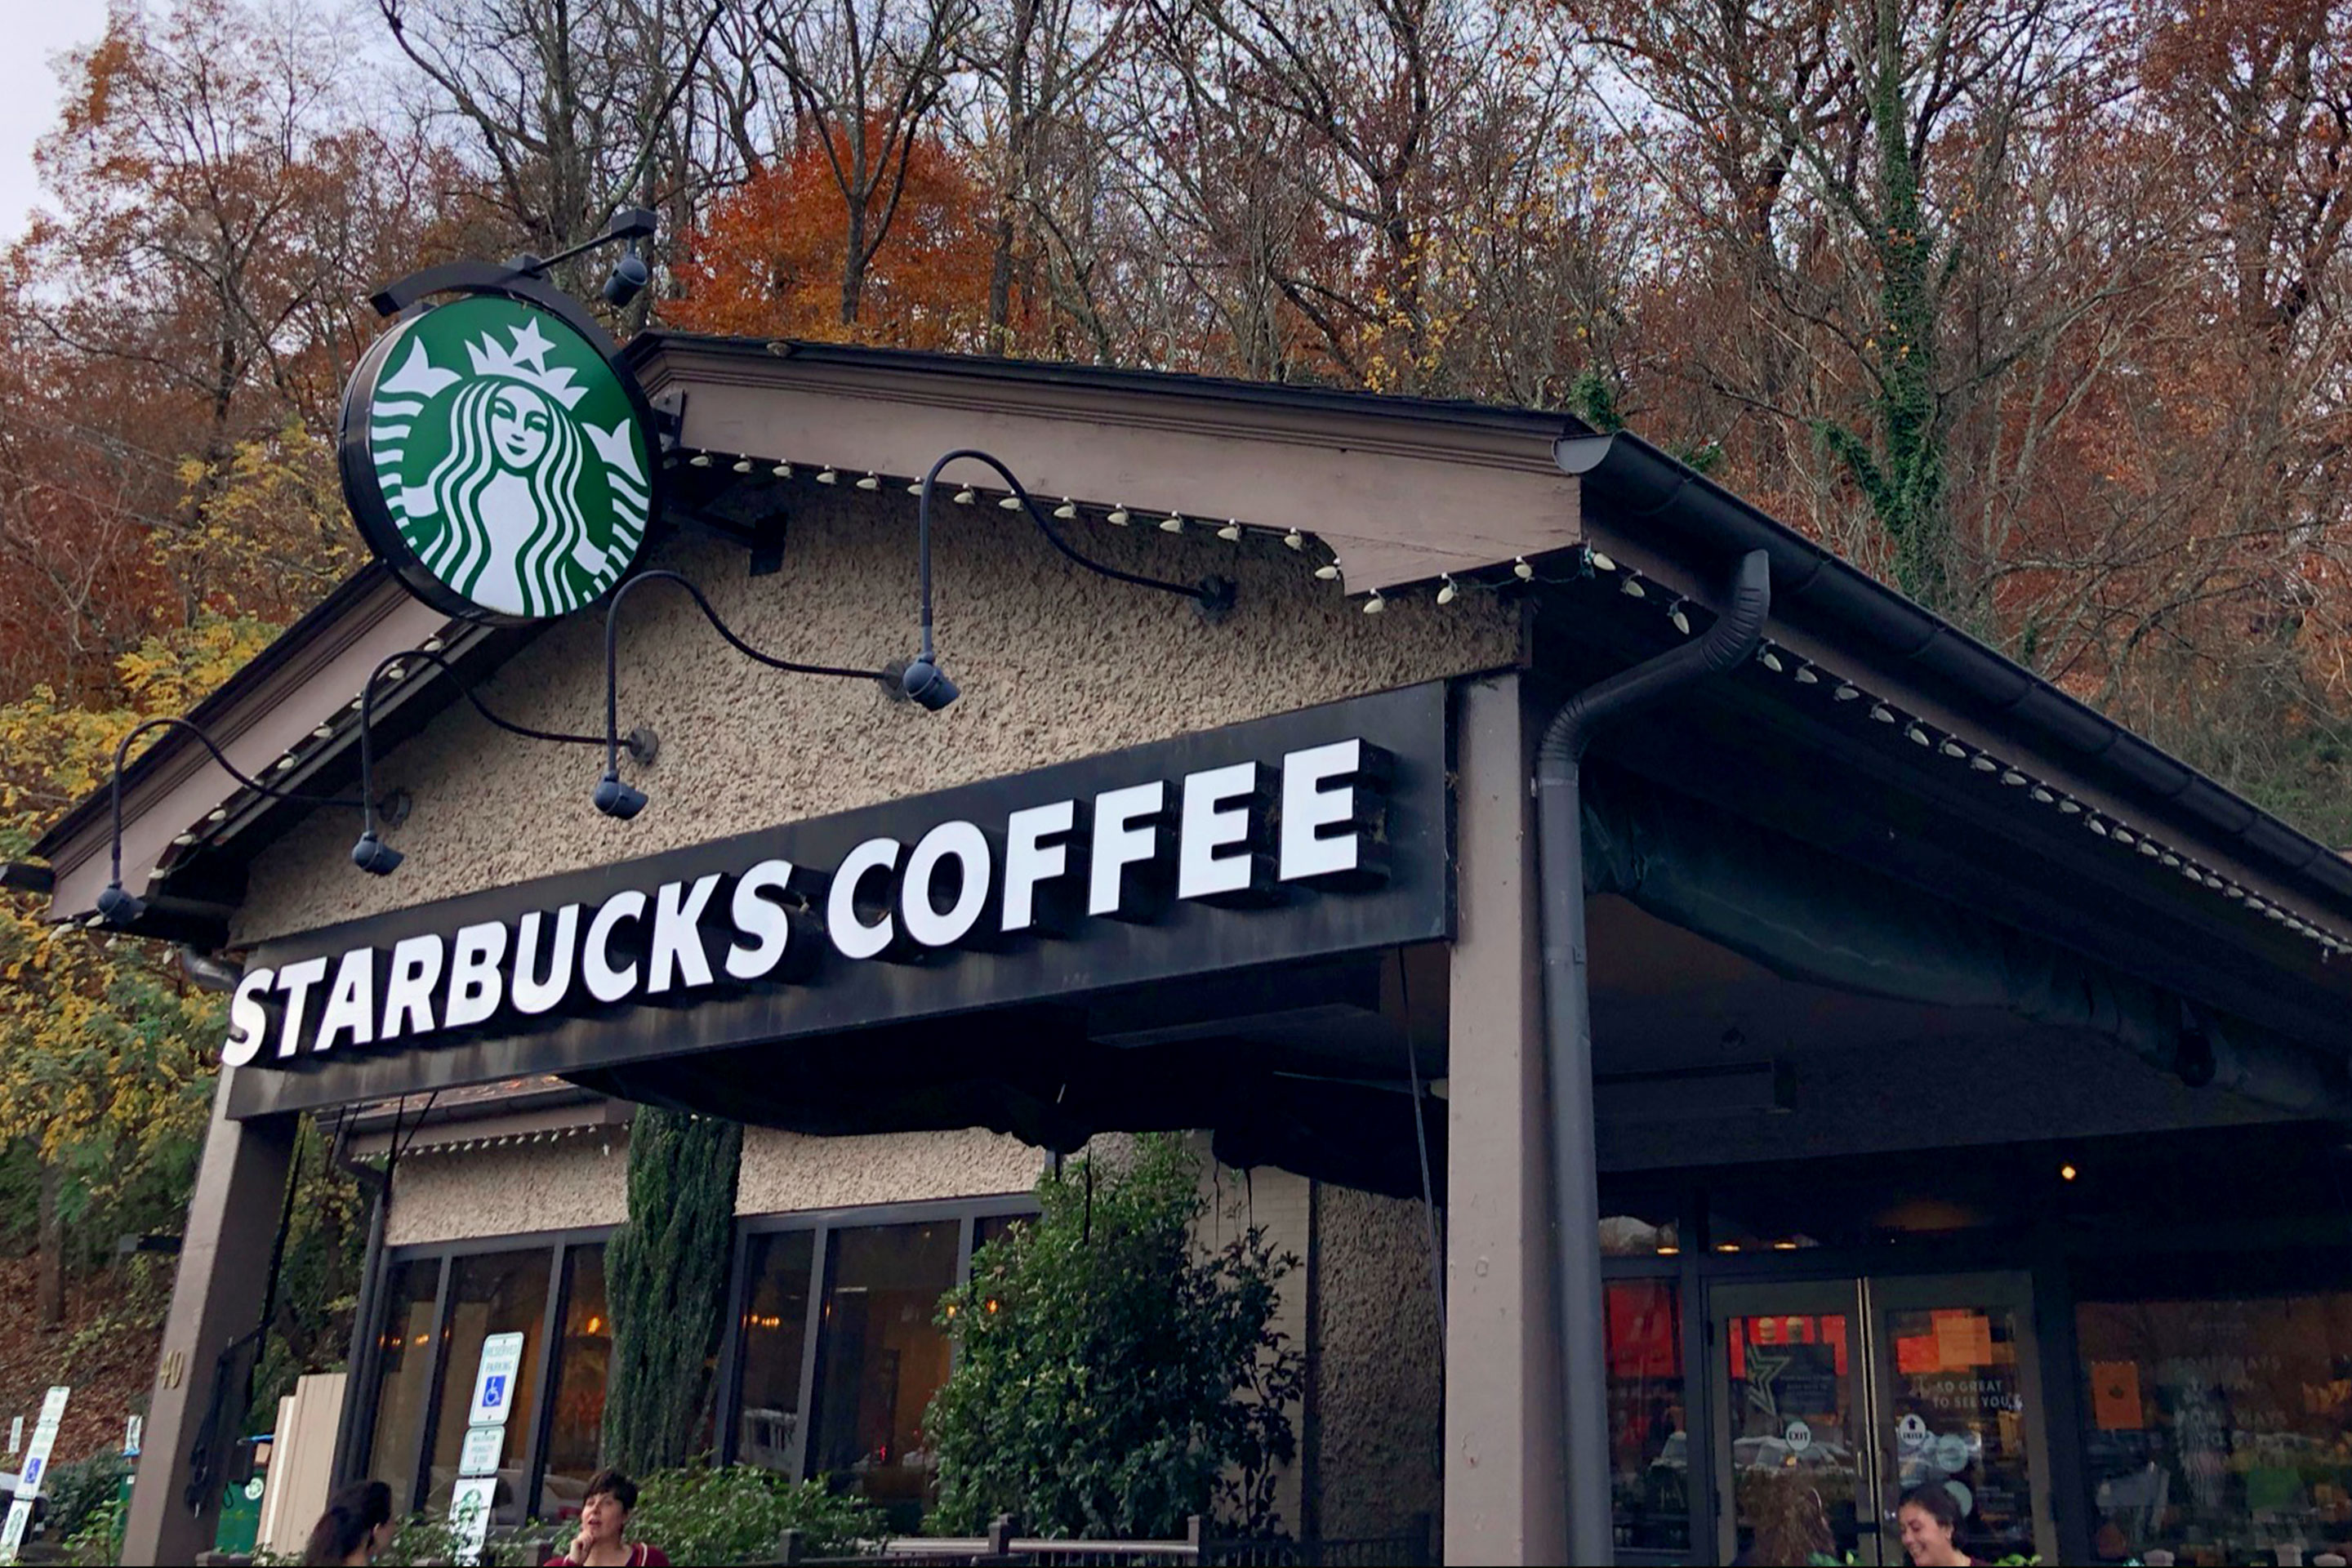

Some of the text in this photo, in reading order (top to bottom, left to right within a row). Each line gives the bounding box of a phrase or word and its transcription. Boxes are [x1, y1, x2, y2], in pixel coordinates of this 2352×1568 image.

[220, 737, 1361, 1067] STARBUCKS COFFEE
[159, 1351, 185, 1388] 40
[486, 1361, 511, 1372] PARKING
[1936, 1379, 2002, 1393] SO GREAT
[1933, 1396, 1949, 1409] TO
[1954, 1396, 1976, 1408] SEE
[1788, 1431, 1808, 1441] EXIT
